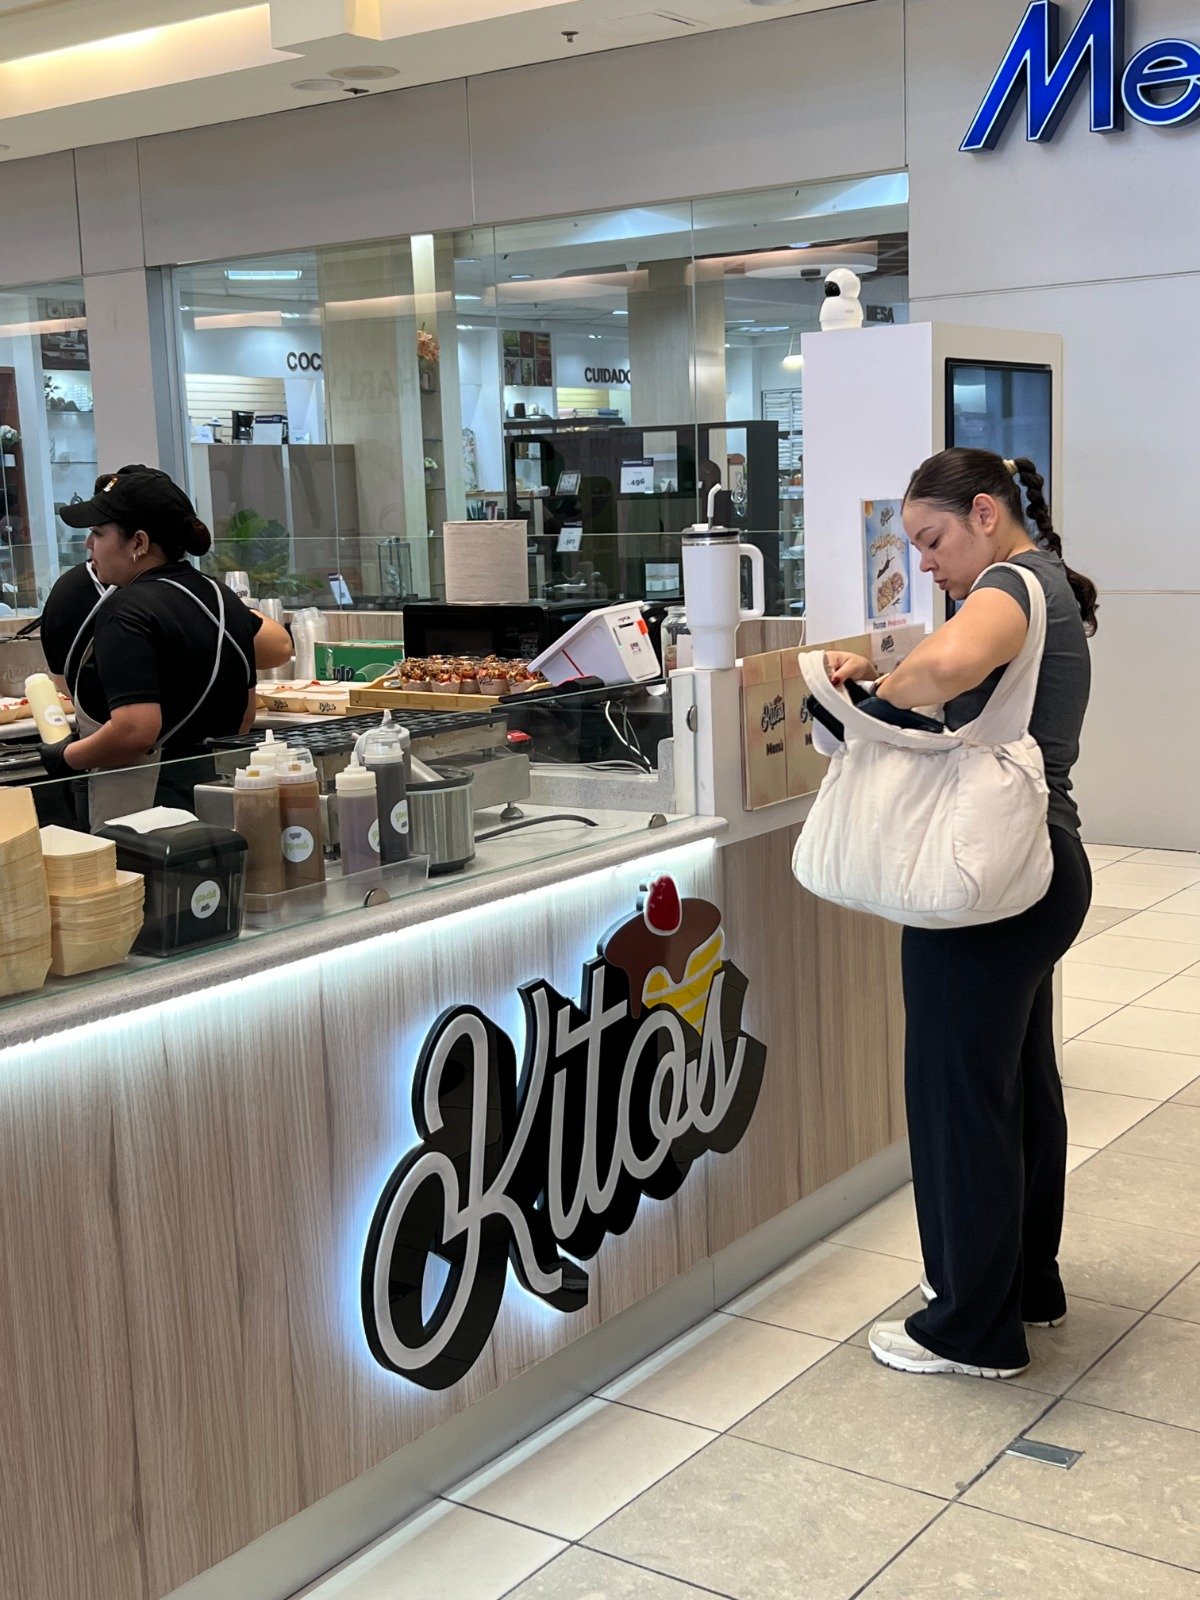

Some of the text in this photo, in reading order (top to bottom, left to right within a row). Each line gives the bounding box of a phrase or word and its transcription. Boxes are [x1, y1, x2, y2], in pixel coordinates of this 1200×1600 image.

[958, 0, 1200, 151] Me
[286, 351, 323, 371] COC
[362, 958, 766, 1390] Kitos
